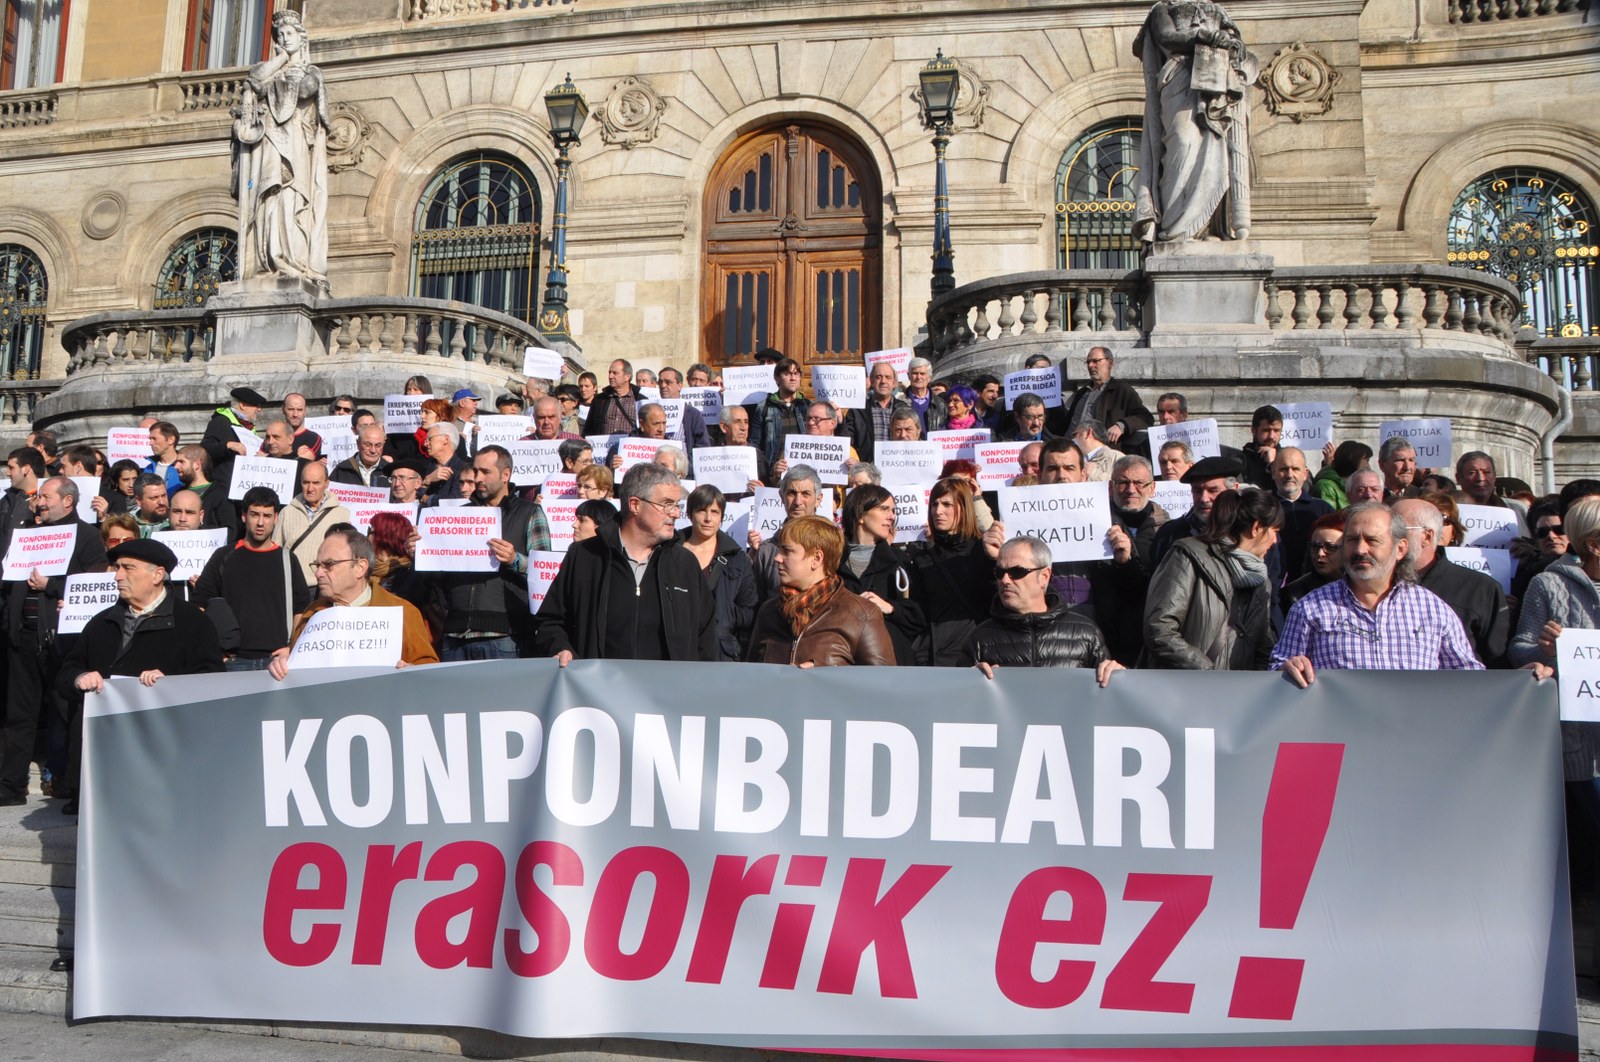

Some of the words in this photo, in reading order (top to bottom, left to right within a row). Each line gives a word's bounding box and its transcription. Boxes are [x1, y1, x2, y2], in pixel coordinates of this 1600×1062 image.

[815, 373, 858, 381] ATXILOTUAK
[1009, 373, 1056, 384] ERREPRESIOA
[1020, 383, 1032, 391] DA
[1032, 381, 1057, 391] BIDEA!
[817, 388, 857, 399] ASKATU!
[309, 422, 350, 431] ATXILOTUAK
[1156, 427, 1210, 441] KONPONBIDEARI
[1386, 428, 1442, 438] ATXILOTUAK
[790, 441, 844, 453] ERREPRESIOA
[789, 451, 799, 460] EZ
[800, 452, 813, 461] DA
[814, 452, 843, 462] BIDEA!
[512, 462, 560, 476] ASKATU!
[699, 465, 733, 473] ERASORIK
[881, 460, 918, 468] ERASORIK
[240, 464, 289, 476] ATXILOTUAK
[1010, 497, 1095, 514] ATXILOTUAK
[424, 516, 497, 525] KONPONBIDEARI
[429, 526, 473, 535] ERASORIK
[474, 526, 489, 536] EZ!
[18, 532, 73, 544] KONPONBIDEARI
[22, 542, 55, 552] ERASORIK
[55, 541, 67, 549] EZ!
[421, 548, 464, 556] ATXILOTUAK
[69, 595, 80, 605] EZ
[83, 595, 98, 605] DA
[297, 639, 355, 653] ERASORIK
[359, 638, 388, 650] EZ!!!
[262, 706, 1216, 850] KONPONBIDEARI
[263, 841, 952, 999] erasorik
